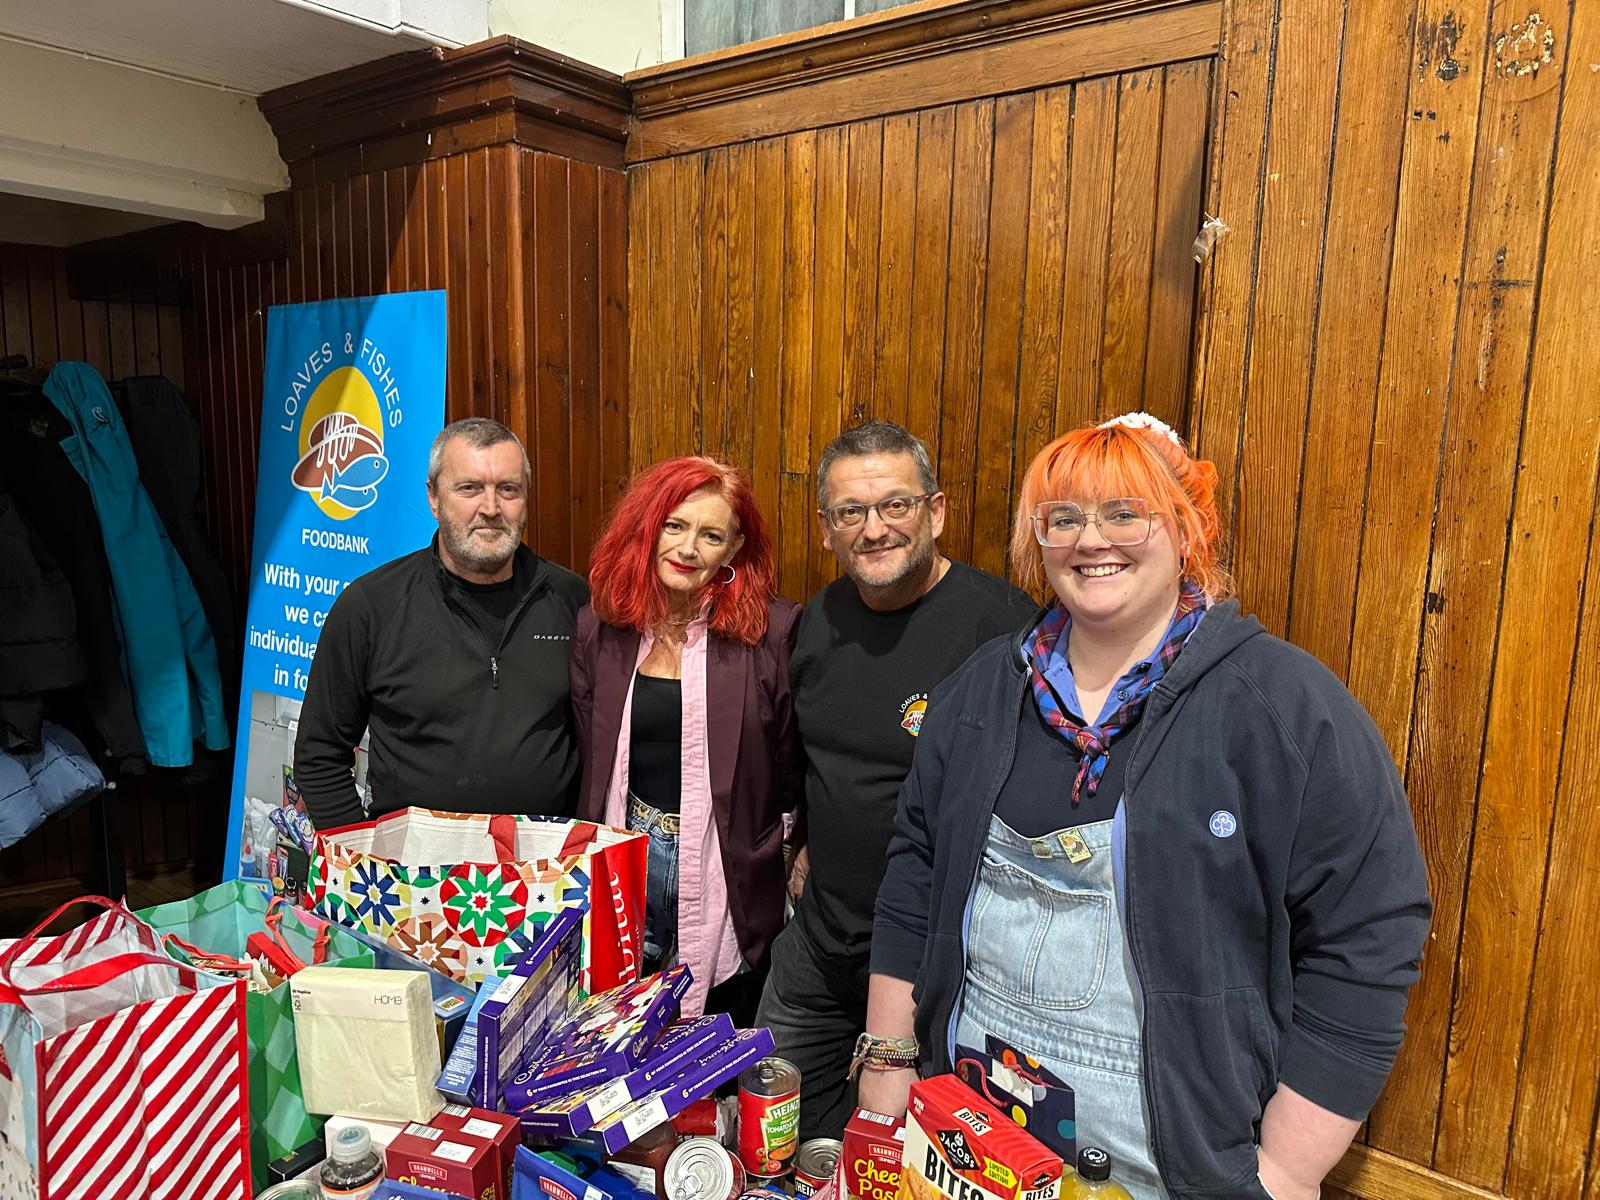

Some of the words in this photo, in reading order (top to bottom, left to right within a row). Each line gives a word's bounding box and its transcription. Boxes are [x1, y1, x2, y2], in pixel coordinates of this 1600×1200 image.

[281, 342, 333, 432] LOAVES
[344, 332, 354, 354] &
[361, 337, 403, 428] FISHES
[301, 528, 370, 555] FOODBANK
[264, 562, 299, 589] With
[304, 574, 339, 596] your
[284, 605, 309, 625] we
[249, 626, 318, 660] individua
[273, 663, 289, 686] in
[293, 668, 309, 691] fo
[898, 693, 920, 714] LOAVES
[374, 994, 403, 1006] HOME
[645, 1071, 652, 1080] 6
[527, 1088, 533, 1097] 6
[682, 1089, 689, 1098] 6
[767, 1122, 790, 1134] TOMATO
[959, 1111, 987, 1133] BITES
[873, 1146, 902, 1161] BRAMWELL
[940, 1132, 975, 1169] JACOB'S
[854, 1159, 901, 1187] Chee
[924, 1143, 985, 1200] BITES
[988, 1170, 1009, 1186] EDITION
[989, 1161, 1009, 1177] LIMITED
[795, 1181, 817, 1197] HEIN
[1026, 1183, 1055, 1200] BITES
